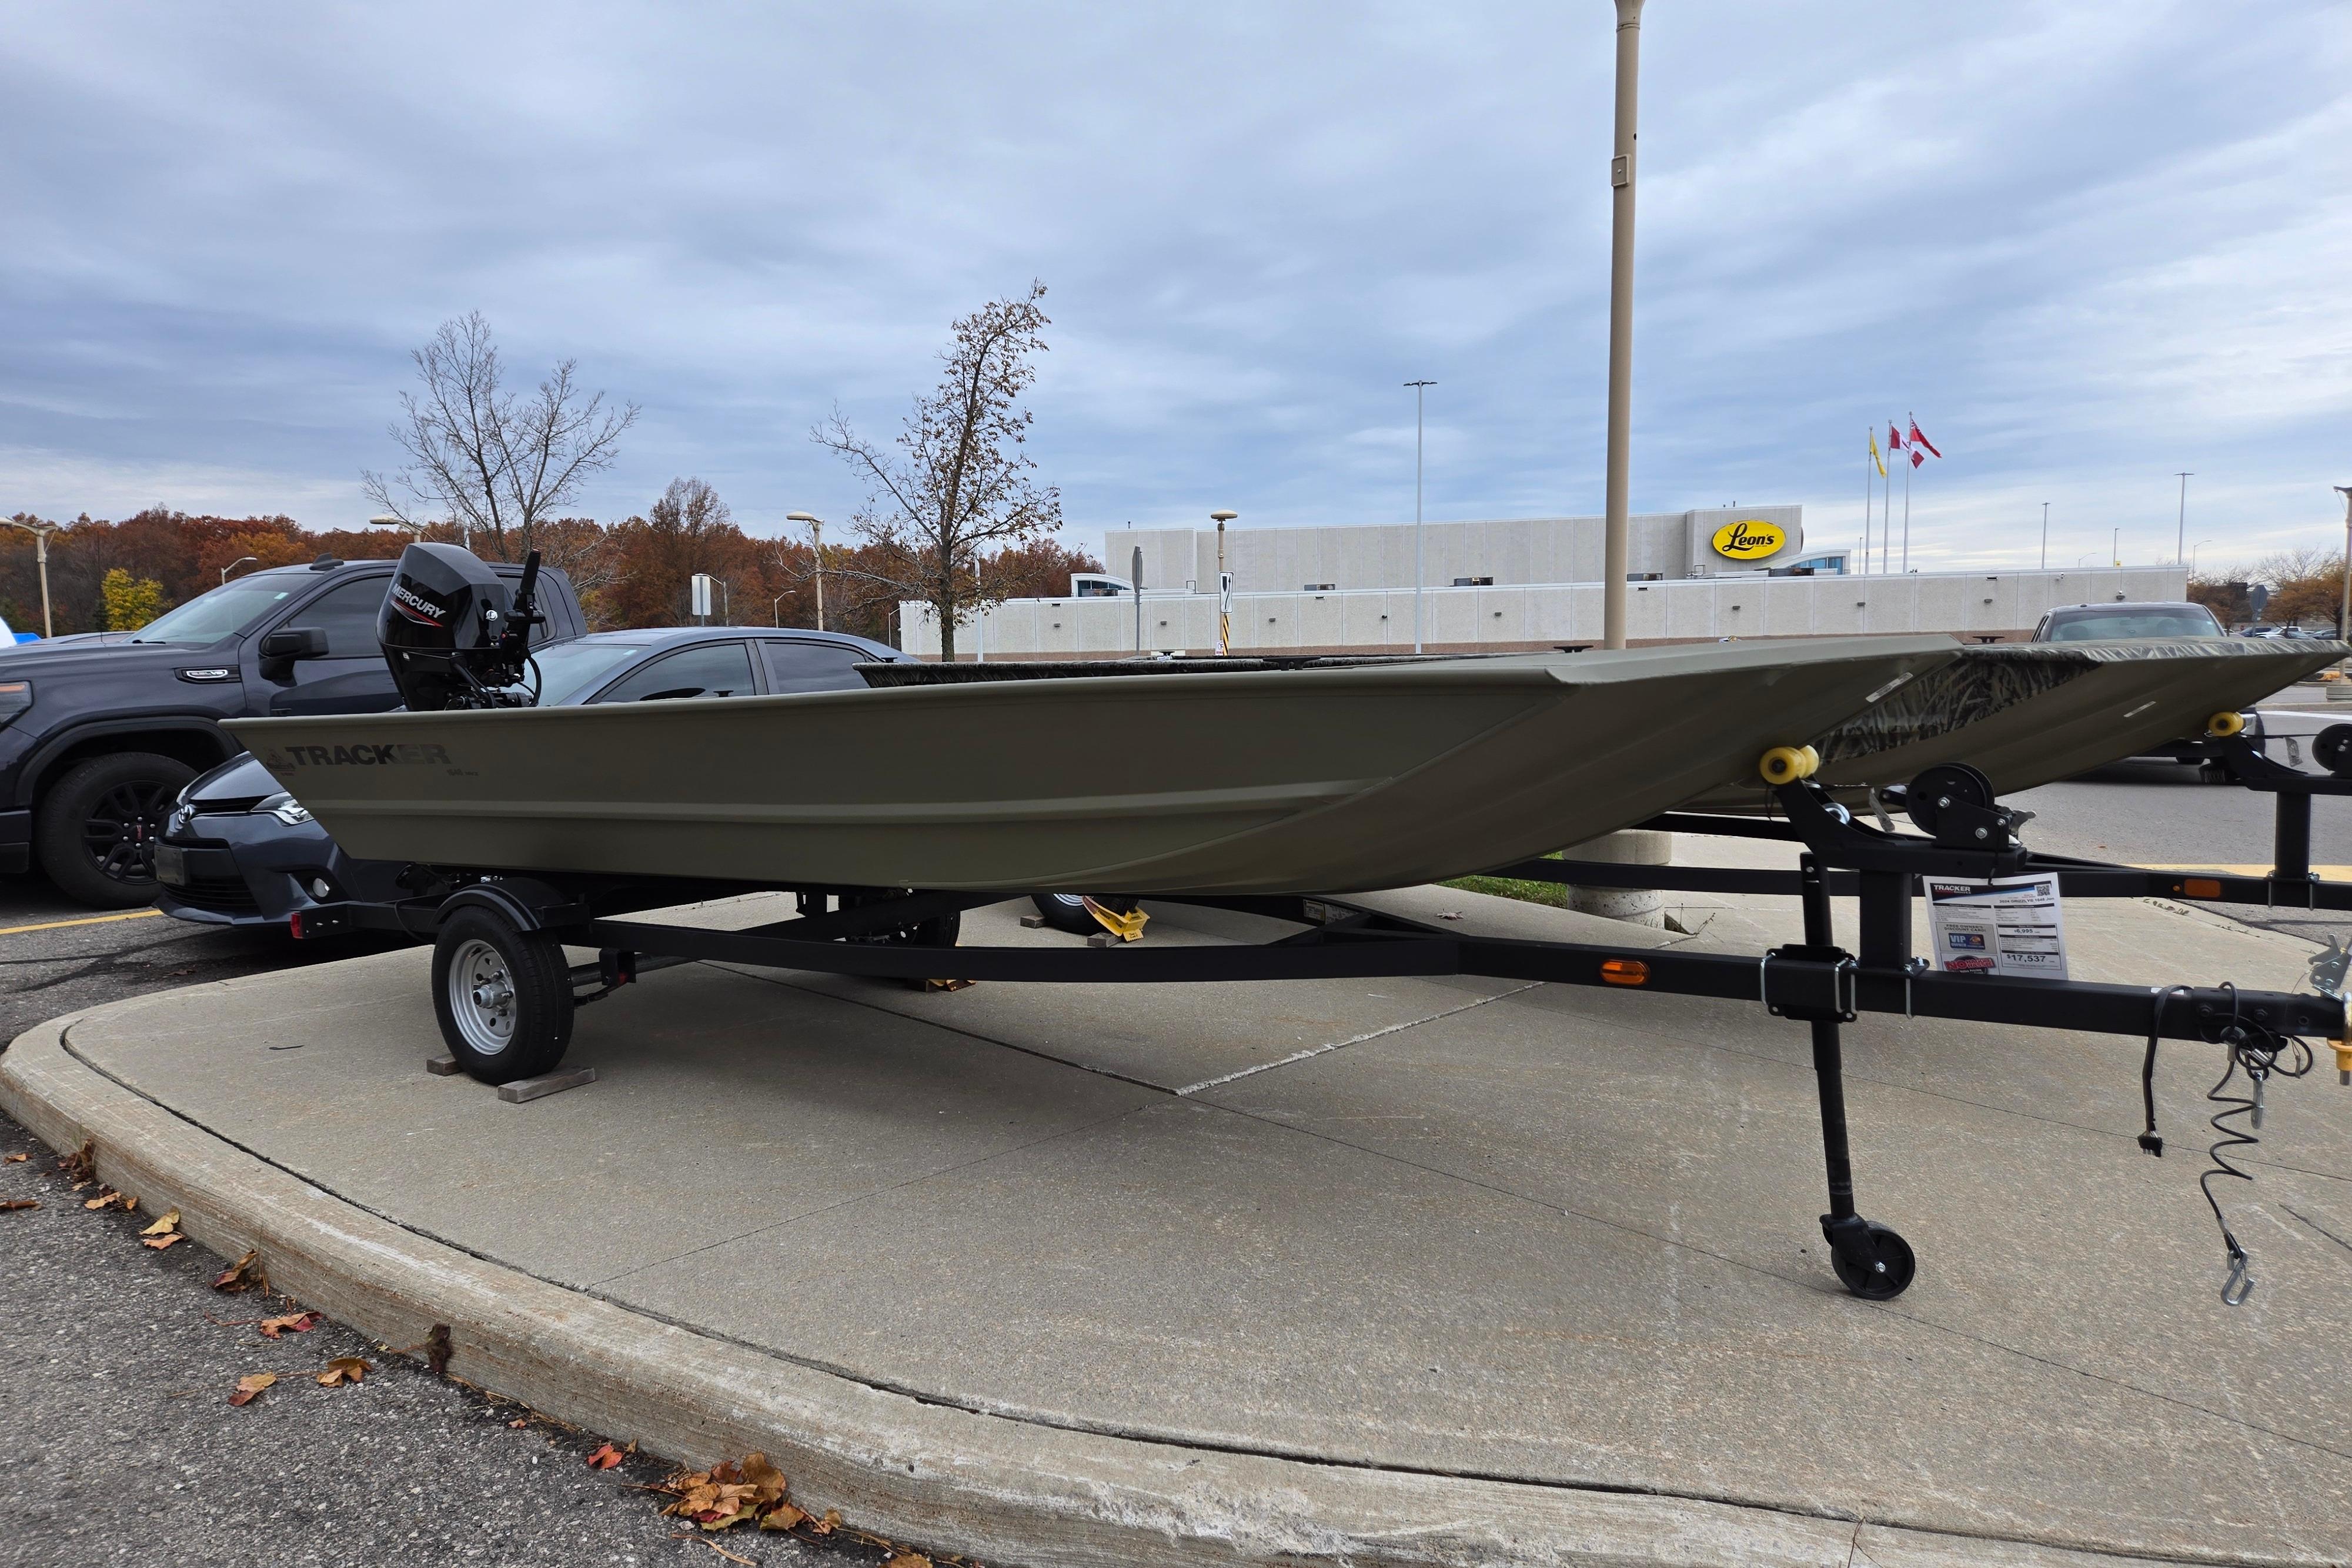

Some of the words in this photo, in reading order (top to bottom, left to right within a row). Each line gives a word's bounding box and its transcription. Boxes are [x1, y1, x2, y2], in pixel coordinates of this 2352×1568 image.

[1722, 523, 1775, 551] Leon's
[391, 583, 446, 618] MERCURY
[285, 744, 451, 765] TRACKER
[1950, 935, 1966, 943] VIP
[1945, 959, 1967, 970] NO
[2006, 954, 2046, 963] $17,537
